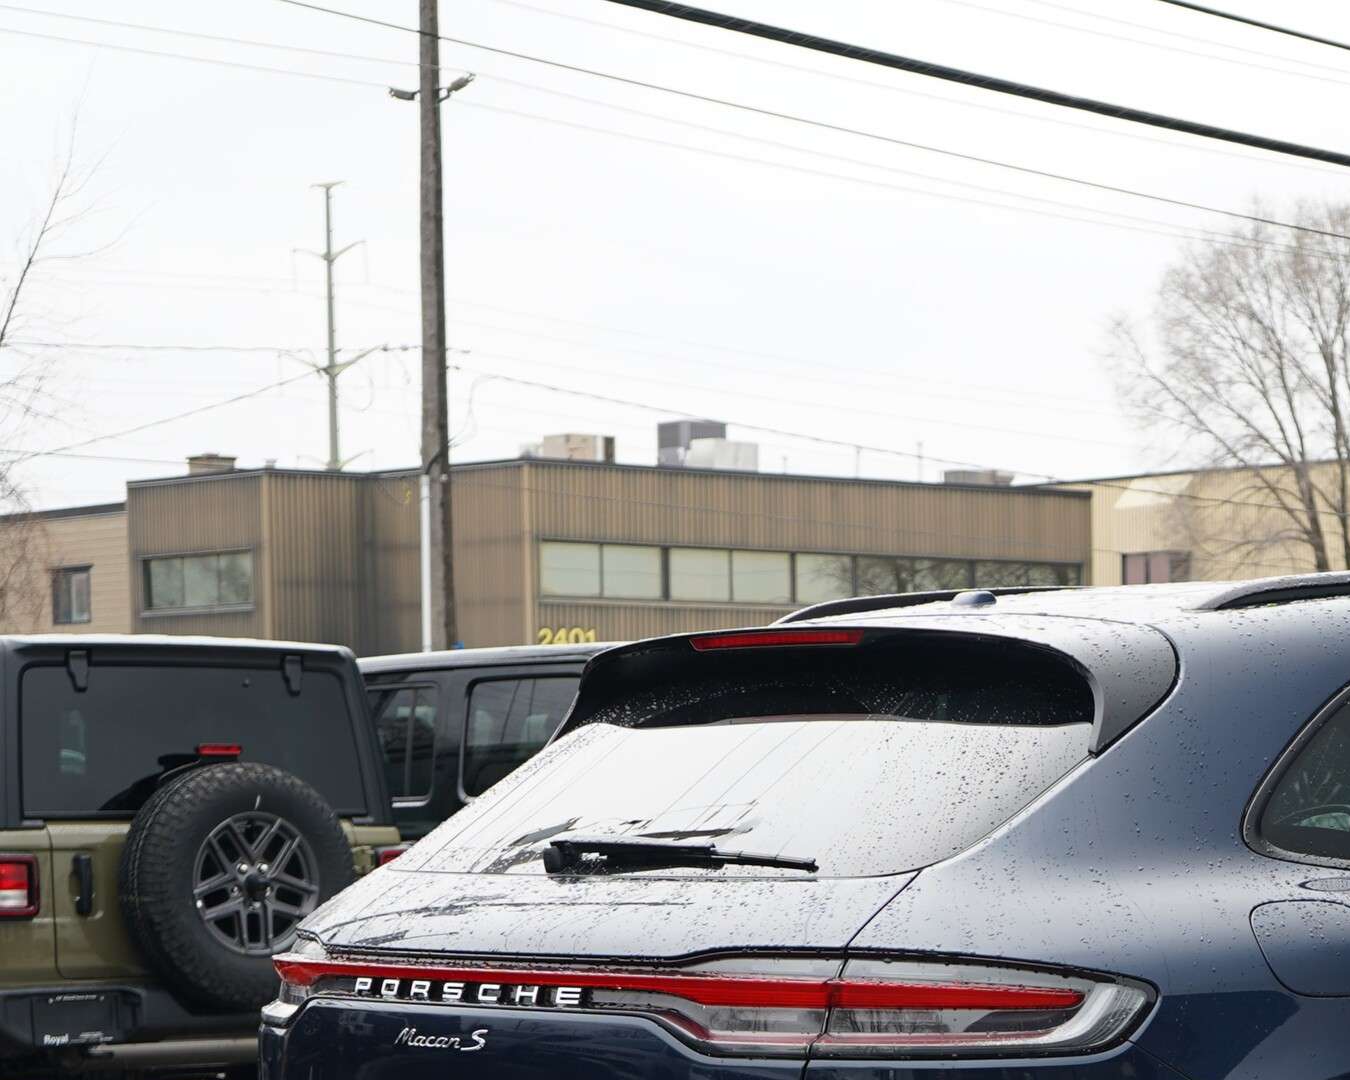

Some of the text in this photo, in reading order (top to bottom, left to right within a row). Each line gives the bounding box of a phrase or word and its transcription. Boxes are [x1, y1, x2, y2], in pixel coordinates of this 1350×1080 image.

[538, 627, 596, 644] 2401
[354, 977, 582, 1005] PORSCHE
[43, 1032, 69, 1047] Royal
[394, 1027, 488, 1051] Macan S
